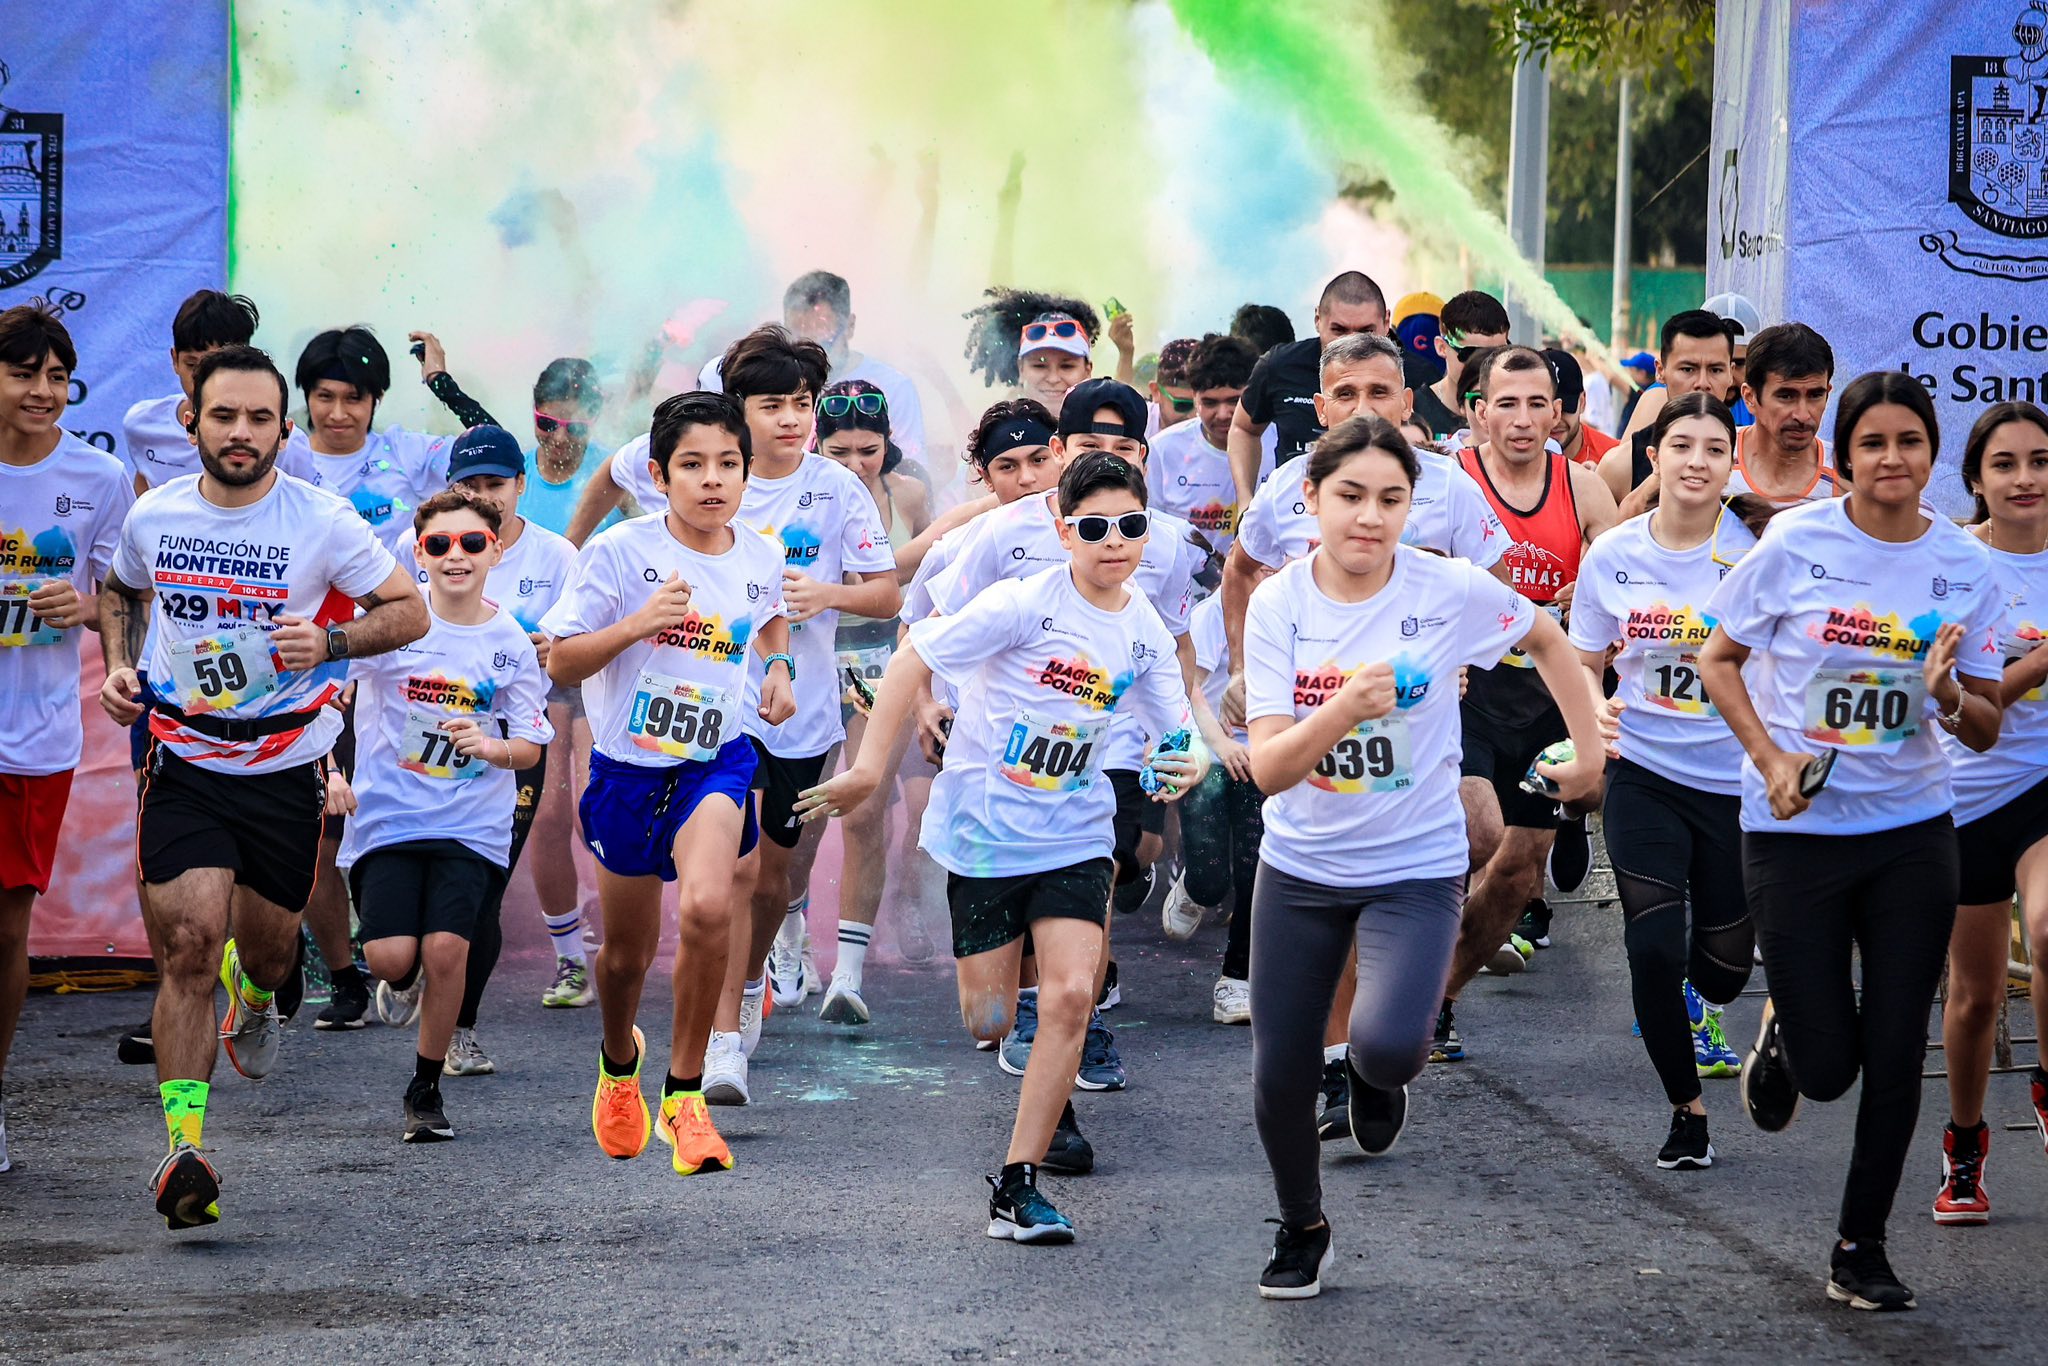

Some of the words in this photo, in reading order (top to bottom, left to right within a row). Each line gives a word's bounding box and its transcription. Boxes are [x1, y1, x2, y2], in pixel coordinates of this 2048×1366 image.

[1984, 61, 1998, 74] 18
[1972, 259, 2014, 273] CULTURA
[2016, 265, 2023, 273] Y
[1912, 311, 2048, 352] Gobie
[1901, 362, 1938, 400] e
[377, 505, 390, 515] 5K
[159, 534, 262, 559] FUNDACIÓN
[267, 545, 291, 561] DE
[20, 555, 54, 568] RUN
[57, 557, 73, 566] 5K
[155, 551, 288, 580] MONTERREY
[1508, 558, 1552, 570] CLUB
[157, 572, 226, 587] CARRERA
[1510, 566, 1562, 587] ENAS
[242, 586, 258, 596] 10K
[266, 589, 279, 598] 5K
[216, 597, 286, 622] MTY
[1627, 612, 1685, 625] MAGIC
[217, 621, 236, 630] AQUÍ
[1826, 610, 1892, 634] MAGIC
[657, 631, 711, 651] COLOR
[1627, 626, 1683, 640] COLOR
[1687, 627, 1712, 640] RU
[1822, 628, 1890, 649] COLOR
[193, 652, 248, 697] 59
[1045, 660, 1101, 685] MAGIC
[407, 678, 460, 693] MAGIC
[1039, 673, 1094, 701] COLOR
[407, 690, 459, 706] COLOR
[1824, 687, 1909, 730] 640
[645, 696, 723, 750] 958
[1020, 736, 1094, 778] 404
